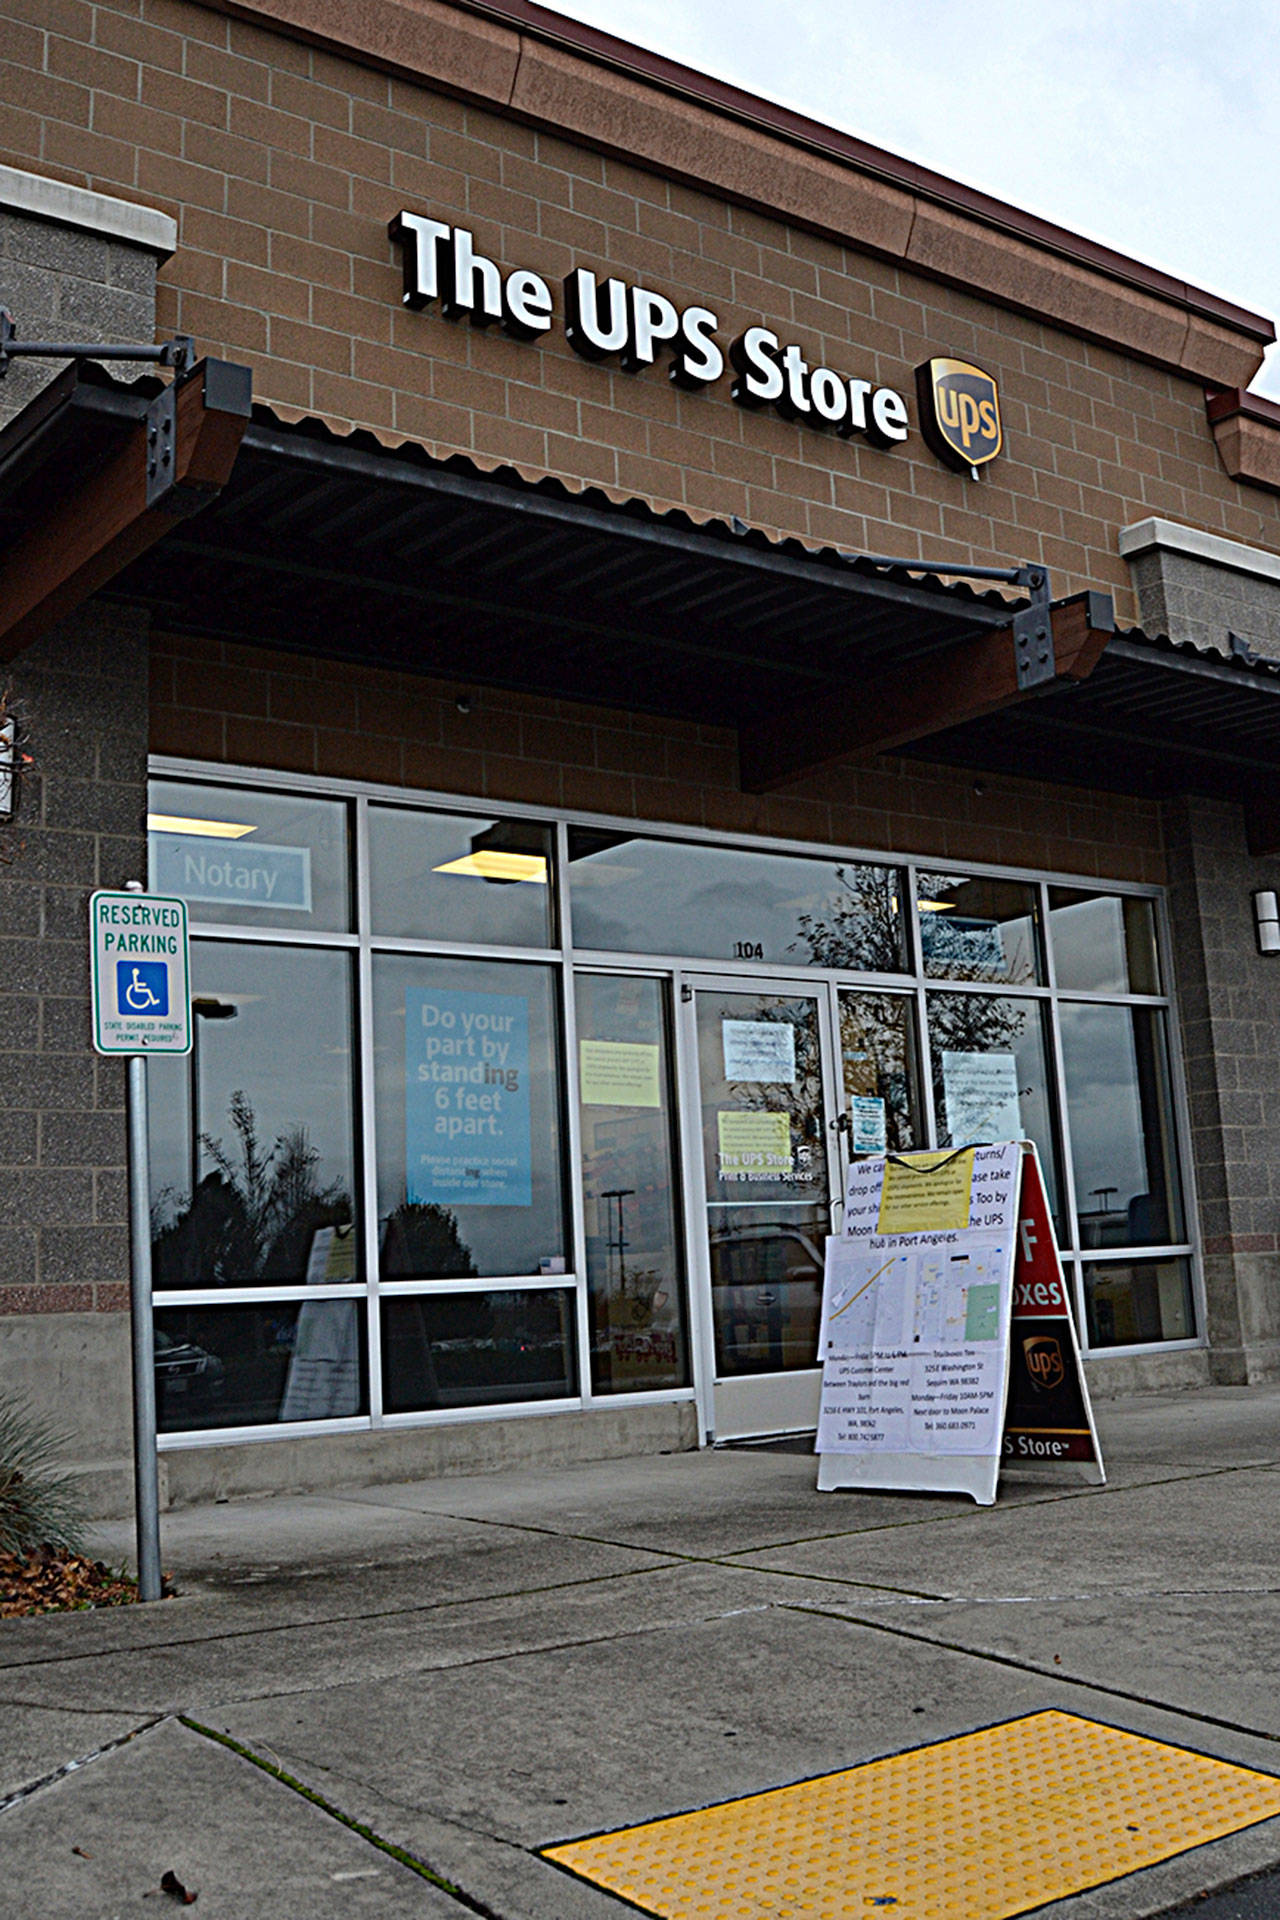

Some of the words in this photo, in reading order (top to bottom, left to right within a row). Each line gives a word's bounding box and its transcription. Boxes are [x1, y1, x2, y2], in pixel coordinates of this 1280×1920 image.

[400, 210, 552, 331] The
[575, 267, 724, 382] UPS
[743, 326, 908, 441] Store
[938, 385, 998, 448] ups
[184, 854, 279, 899] Notary
[100, 905, 181, 928] RESERVED
[104, 933, 178, 955] PARKING
[736, 941, 764, 960] 104
[421, 1003, 457, 1028] Do
[461, 1012, 515, 1036] your
[426, 1035, 477, 1060] part
[481, 1034, 510, 1065] by
[417, 1061, 520, 1092] standing
[435, 1086, 451, 1110] 6
[455, 1087, 502, 1112] feet
[434, 1114, 503, 1140] apart.
[718, 1152, 739, 1166] The
[742, 1152, 763, 1166] UPS
[766, 1152, 794, 1166] Store
[857, 1163, 872, 1175] We
[848, 1184, 868, 1198] drop
[990, 1169, 1012, 1182] take
[847, 1207, 867, 1220] your
[976, 1192, 994, 1205] Too
[995, 1190, 1008, 1205] by
[847, 1225, 874, 1238] Moon
[969, 1215, 983, 1227] he
[984, 1213, 1004, 1227] UPS
[869, 1237, 886, 1250] hub
[888, 1236, 897, 1248] in
[899, 1235, 918, 1248] Port
[1029, 1351, 1062, 1381] ups
